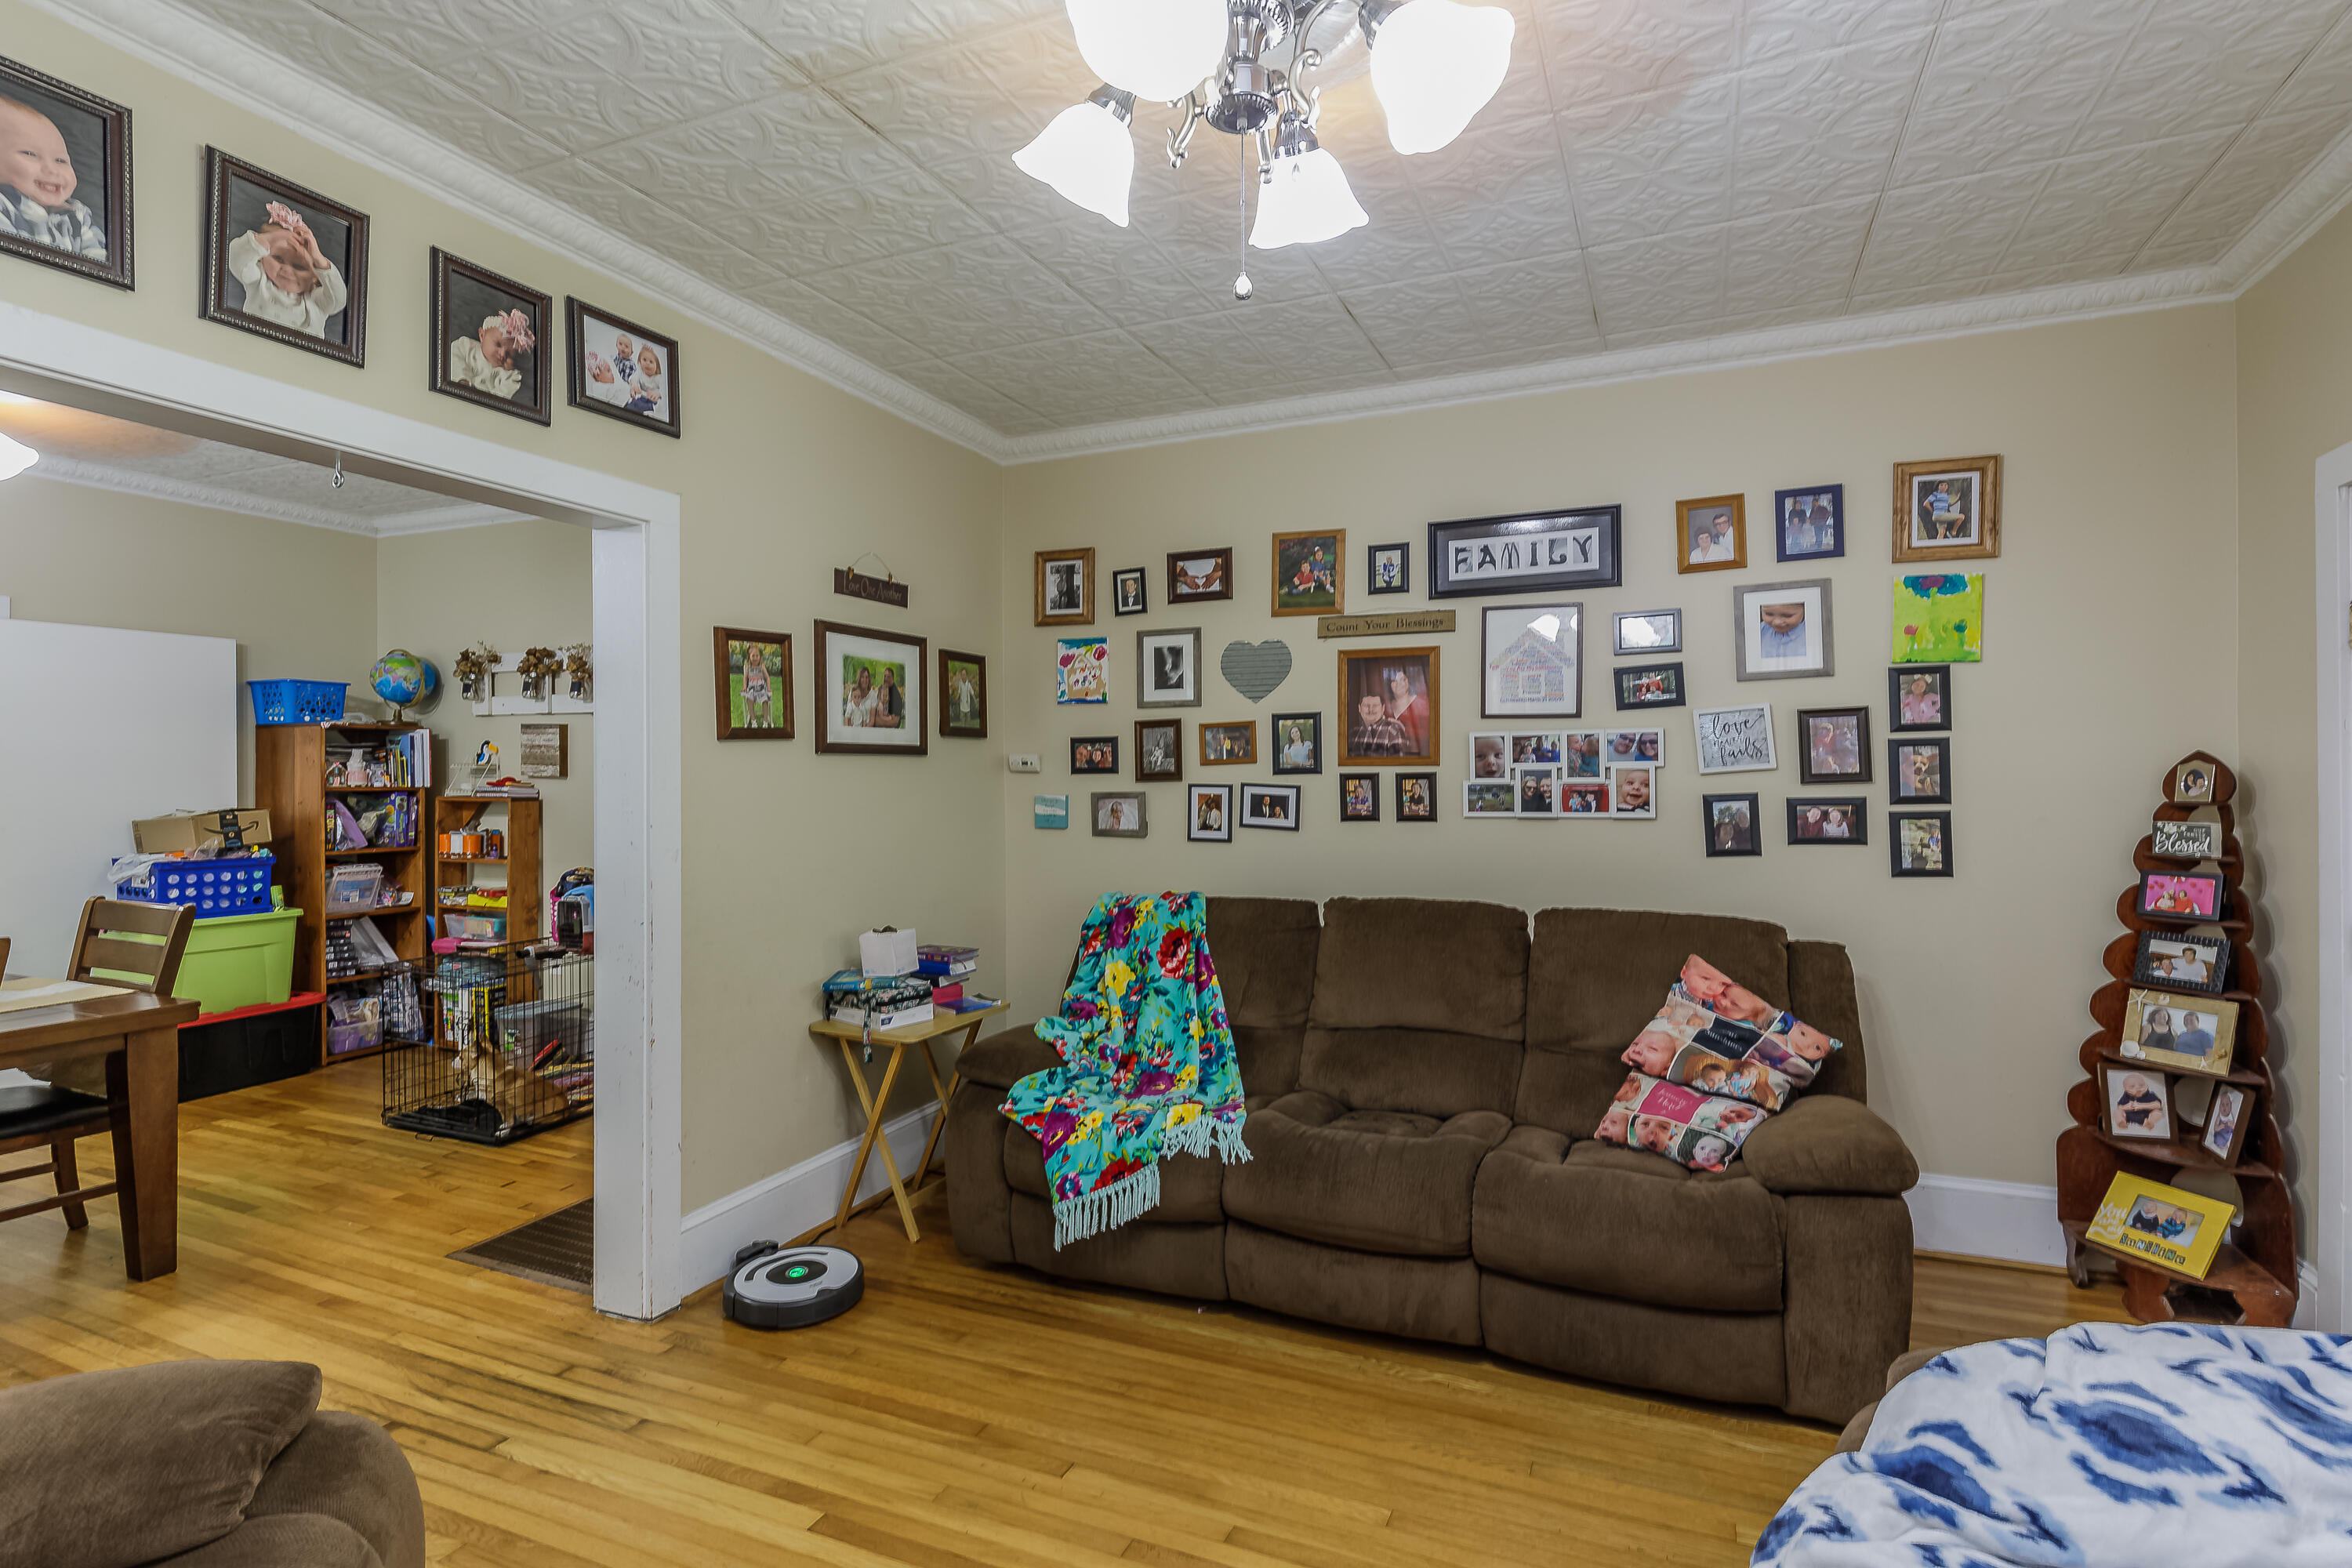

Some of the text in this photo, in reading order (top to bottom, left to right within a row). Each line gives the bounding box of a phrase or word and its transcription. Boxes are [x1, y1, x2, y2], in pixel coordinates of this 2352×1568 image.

[1454, 534, 1593, 574] FAMILY
[844, 571, 902, 601] Love One Another
[1327, 617, 1444, 633] Count Your Blessings
[1711, 713, 1764, 740] love
[1720, 736, 1766, 766] fails
[2155, 831, 2210, 854] Blessed
